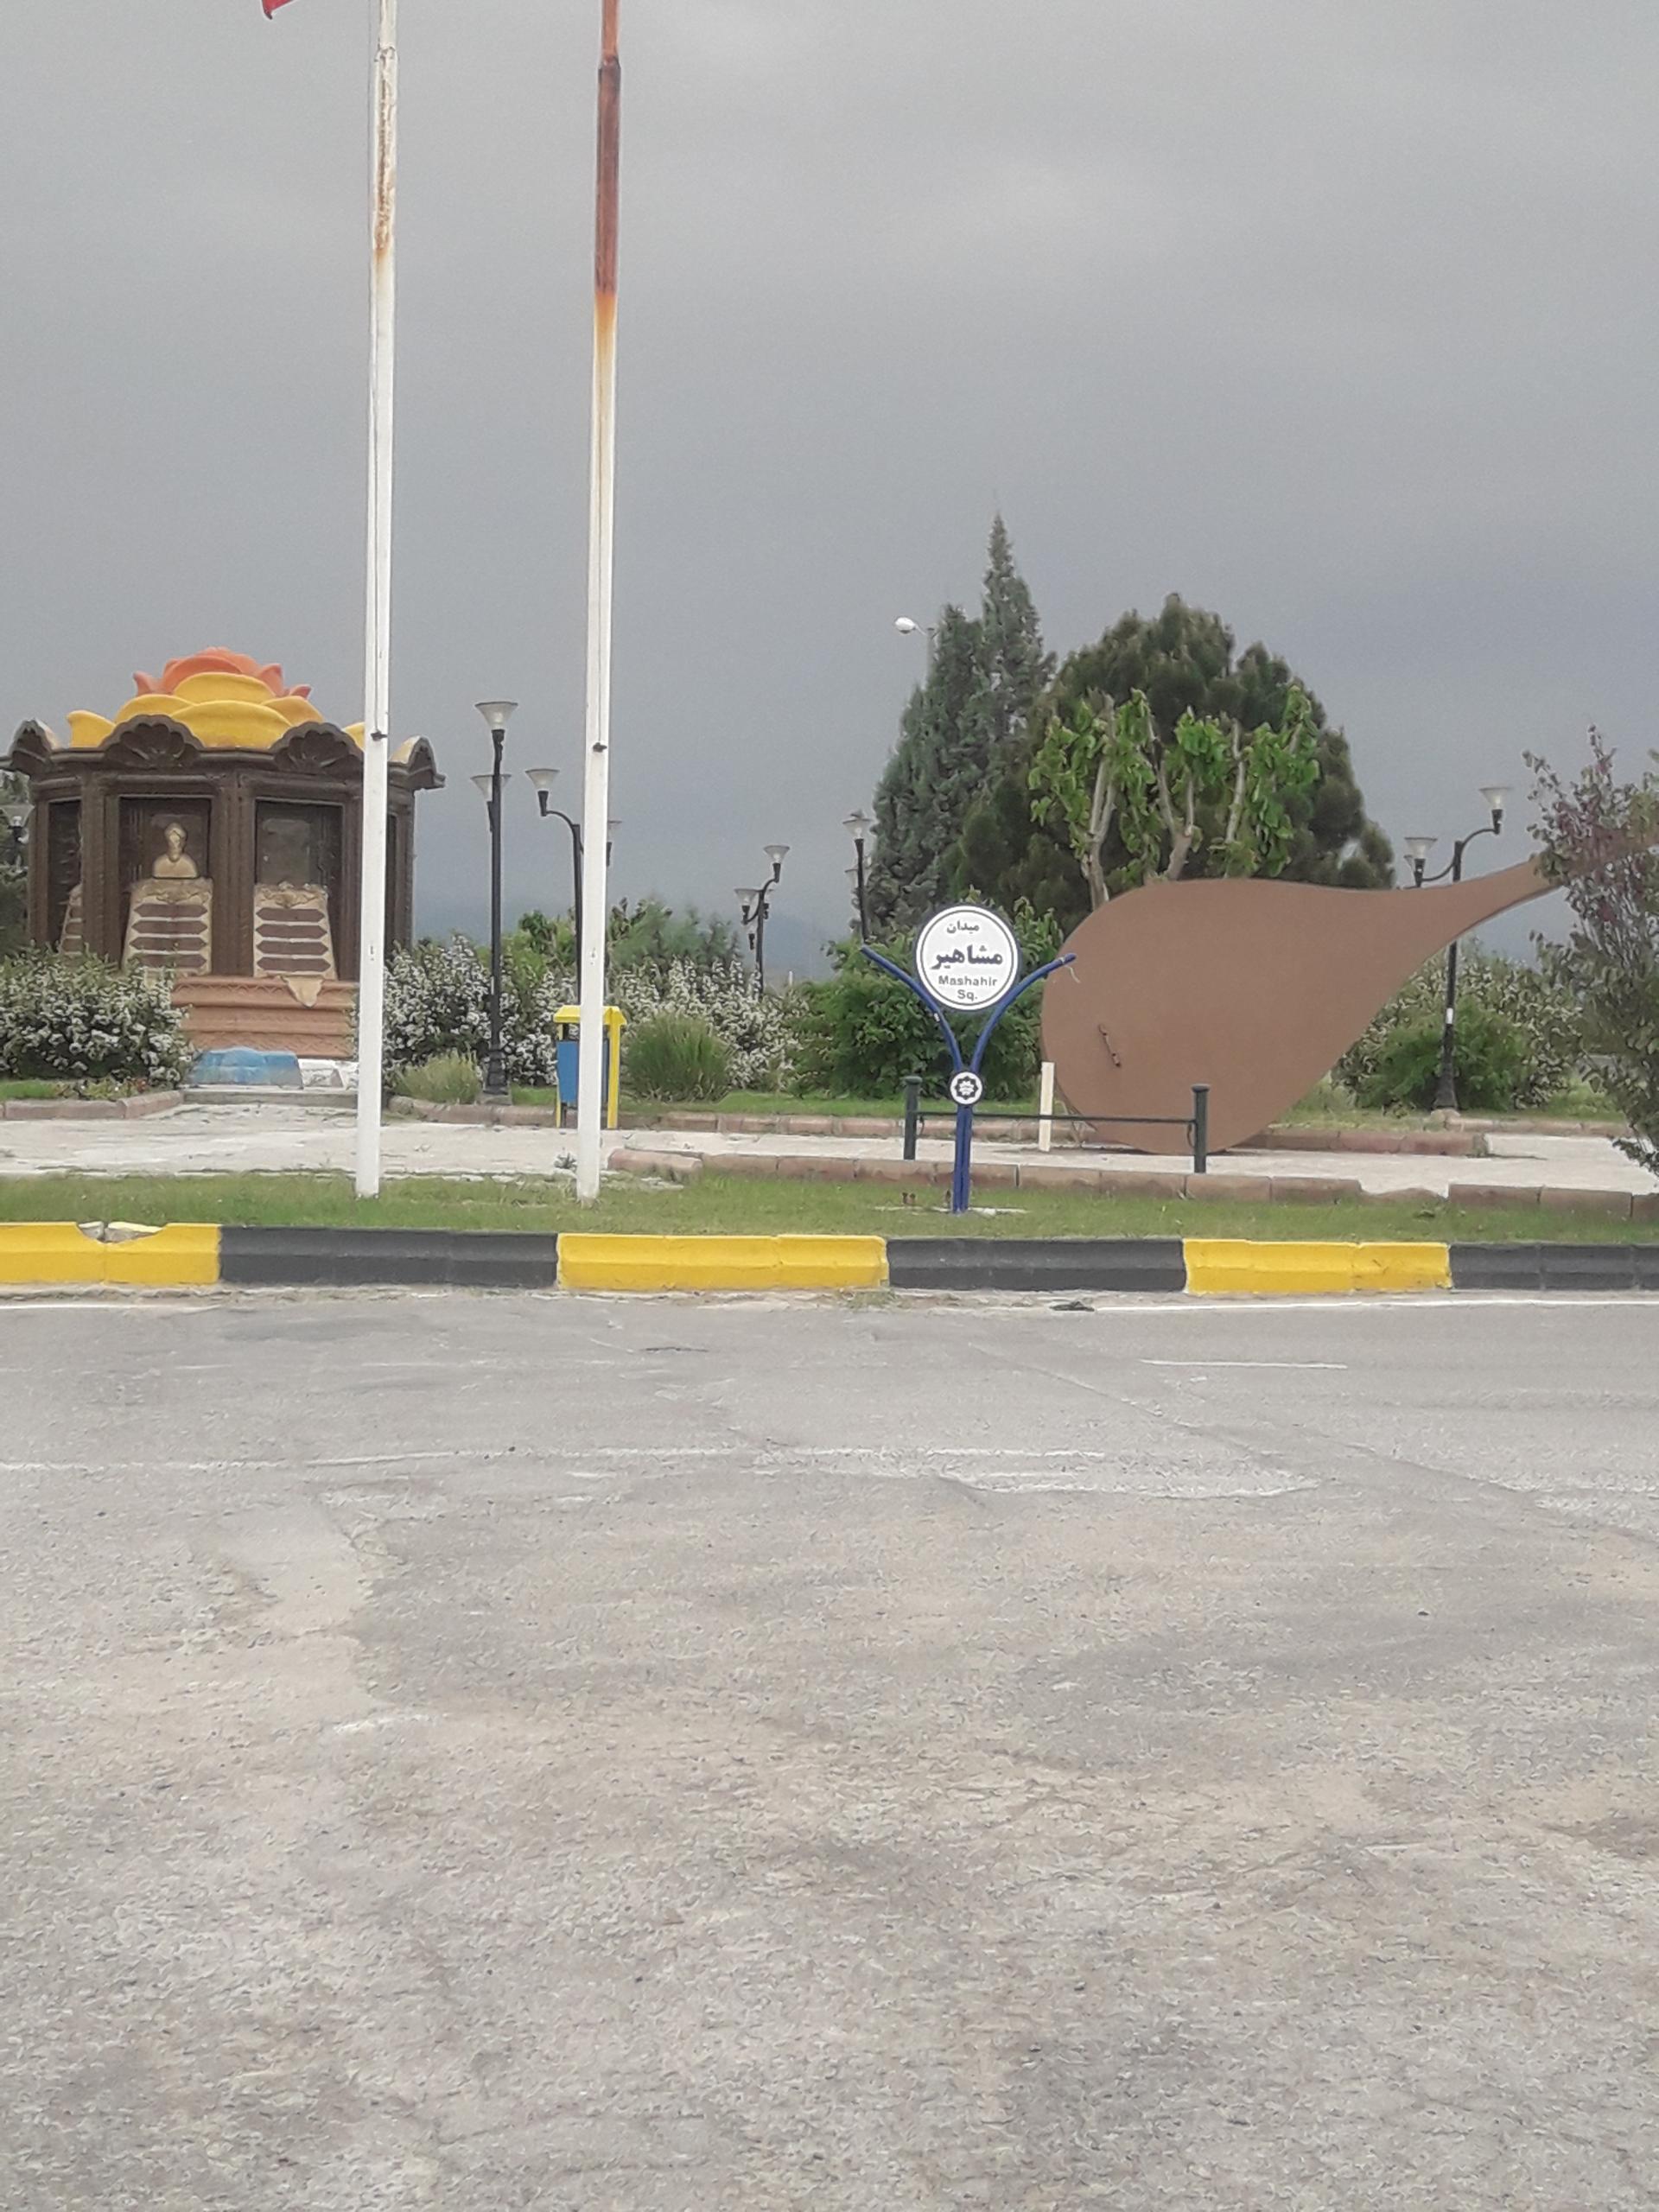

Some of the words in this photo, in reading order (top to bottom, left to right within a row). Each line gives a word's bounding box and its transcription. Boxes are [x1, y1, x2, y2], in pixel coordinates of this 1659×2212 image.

[946, 920, 980, 934] میدان
[931, 944, 1003, 969] مشاهیر
[938, 975, 998, 987] Mashahir
[957, 989, 978, 1001] Sq.
